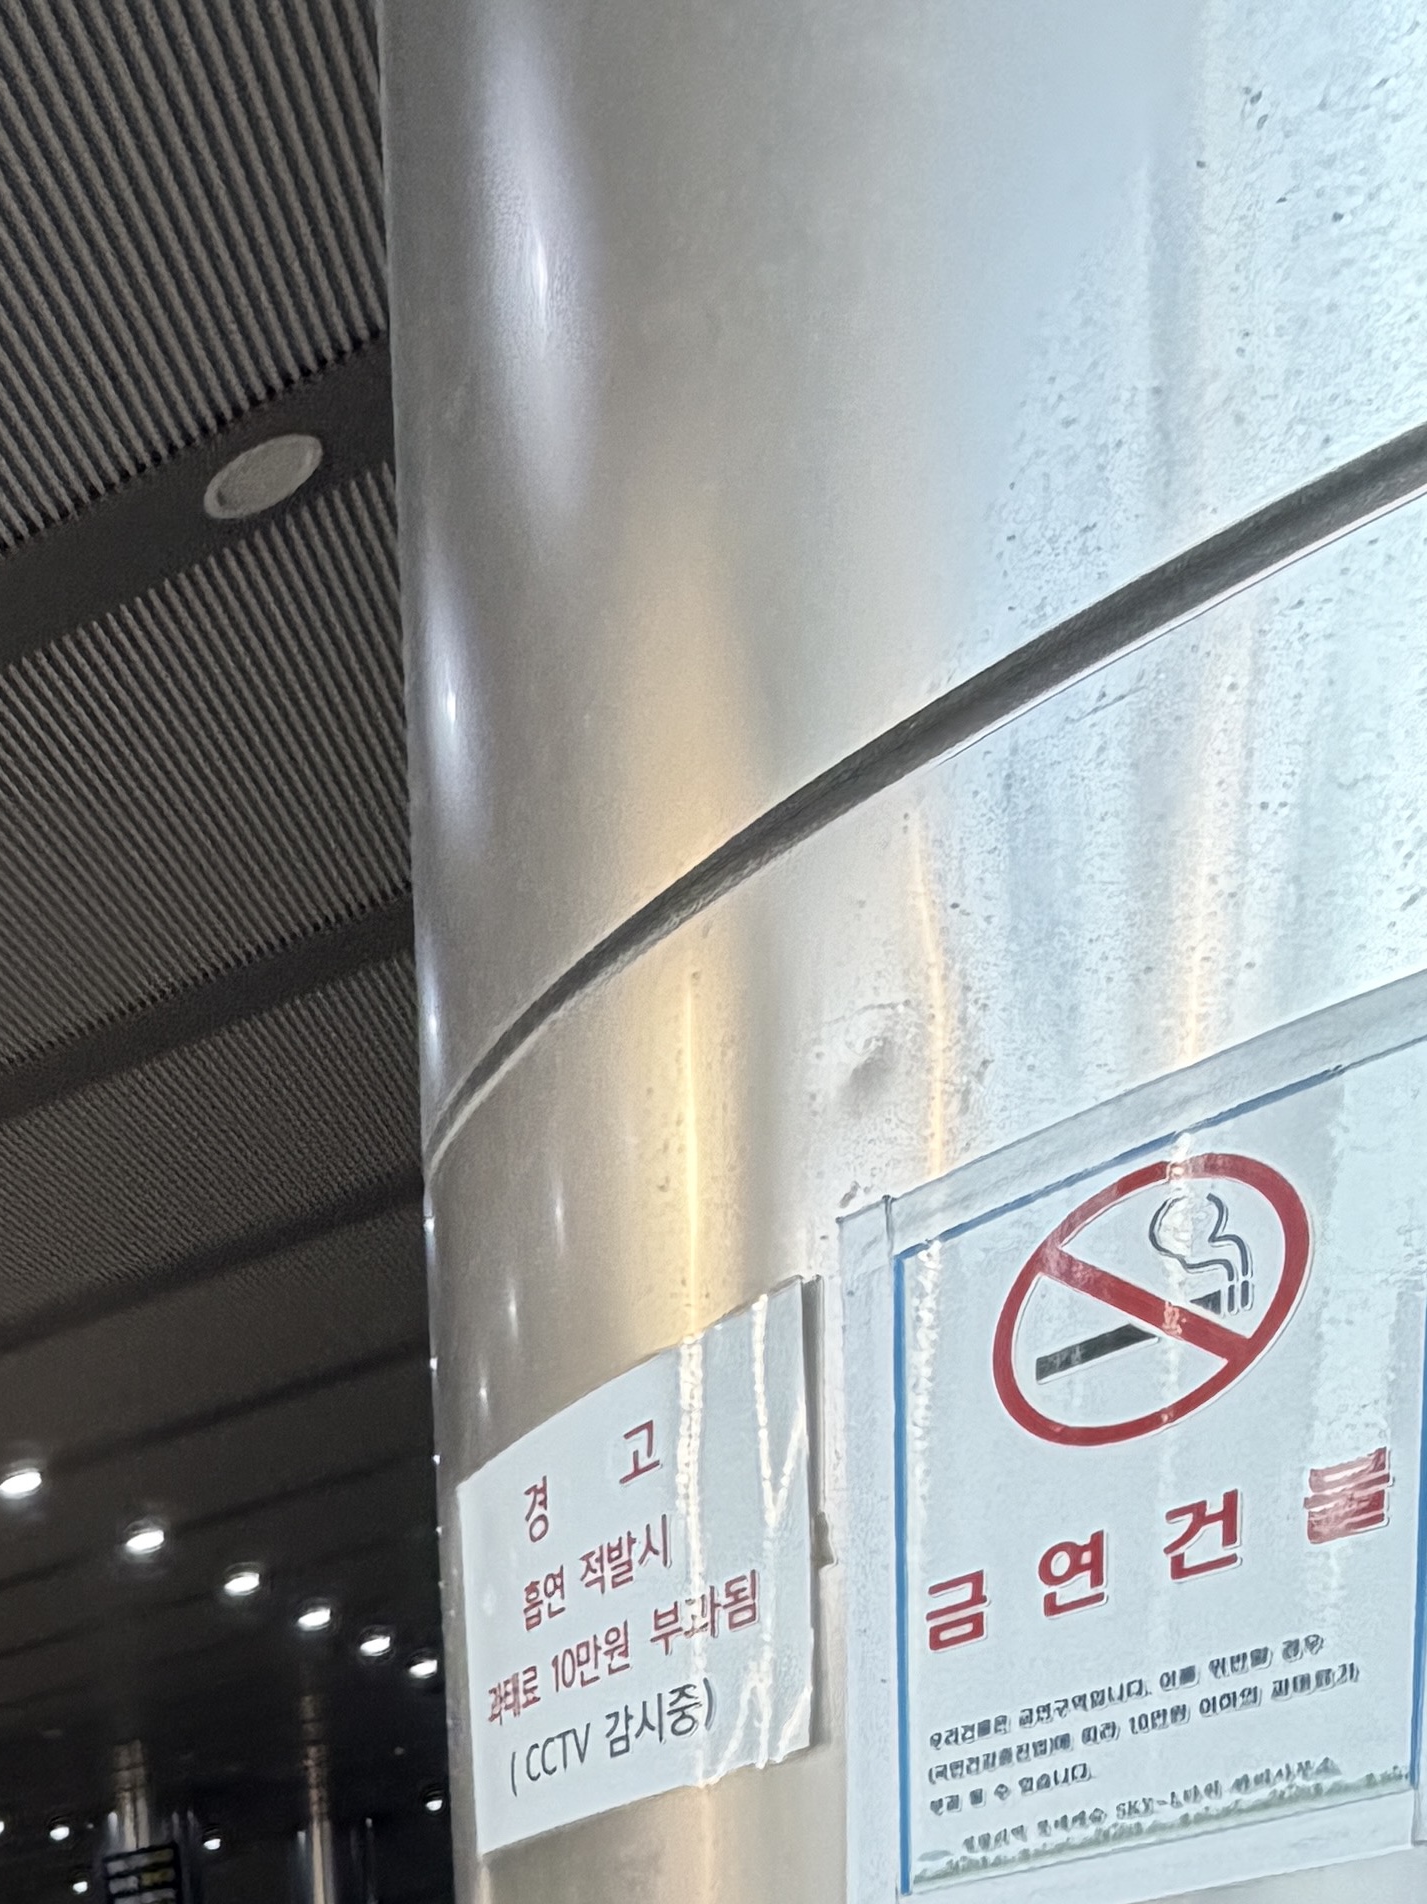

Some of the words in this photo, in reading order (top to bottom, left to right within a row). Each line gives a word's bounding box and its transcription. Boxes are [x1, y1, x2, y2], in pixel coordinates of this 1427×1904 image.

[523, 1566, 566, 1631] 흡연
[580, 1514, 669, 1594] 적발시
[551, 1621, 631, 1692] 10만원
[649, 1569, 761, 1656] 부과됨
[510, 1722, 591, 1797] (CCTV
[605, 1678, 714, 1758] 감시중)
